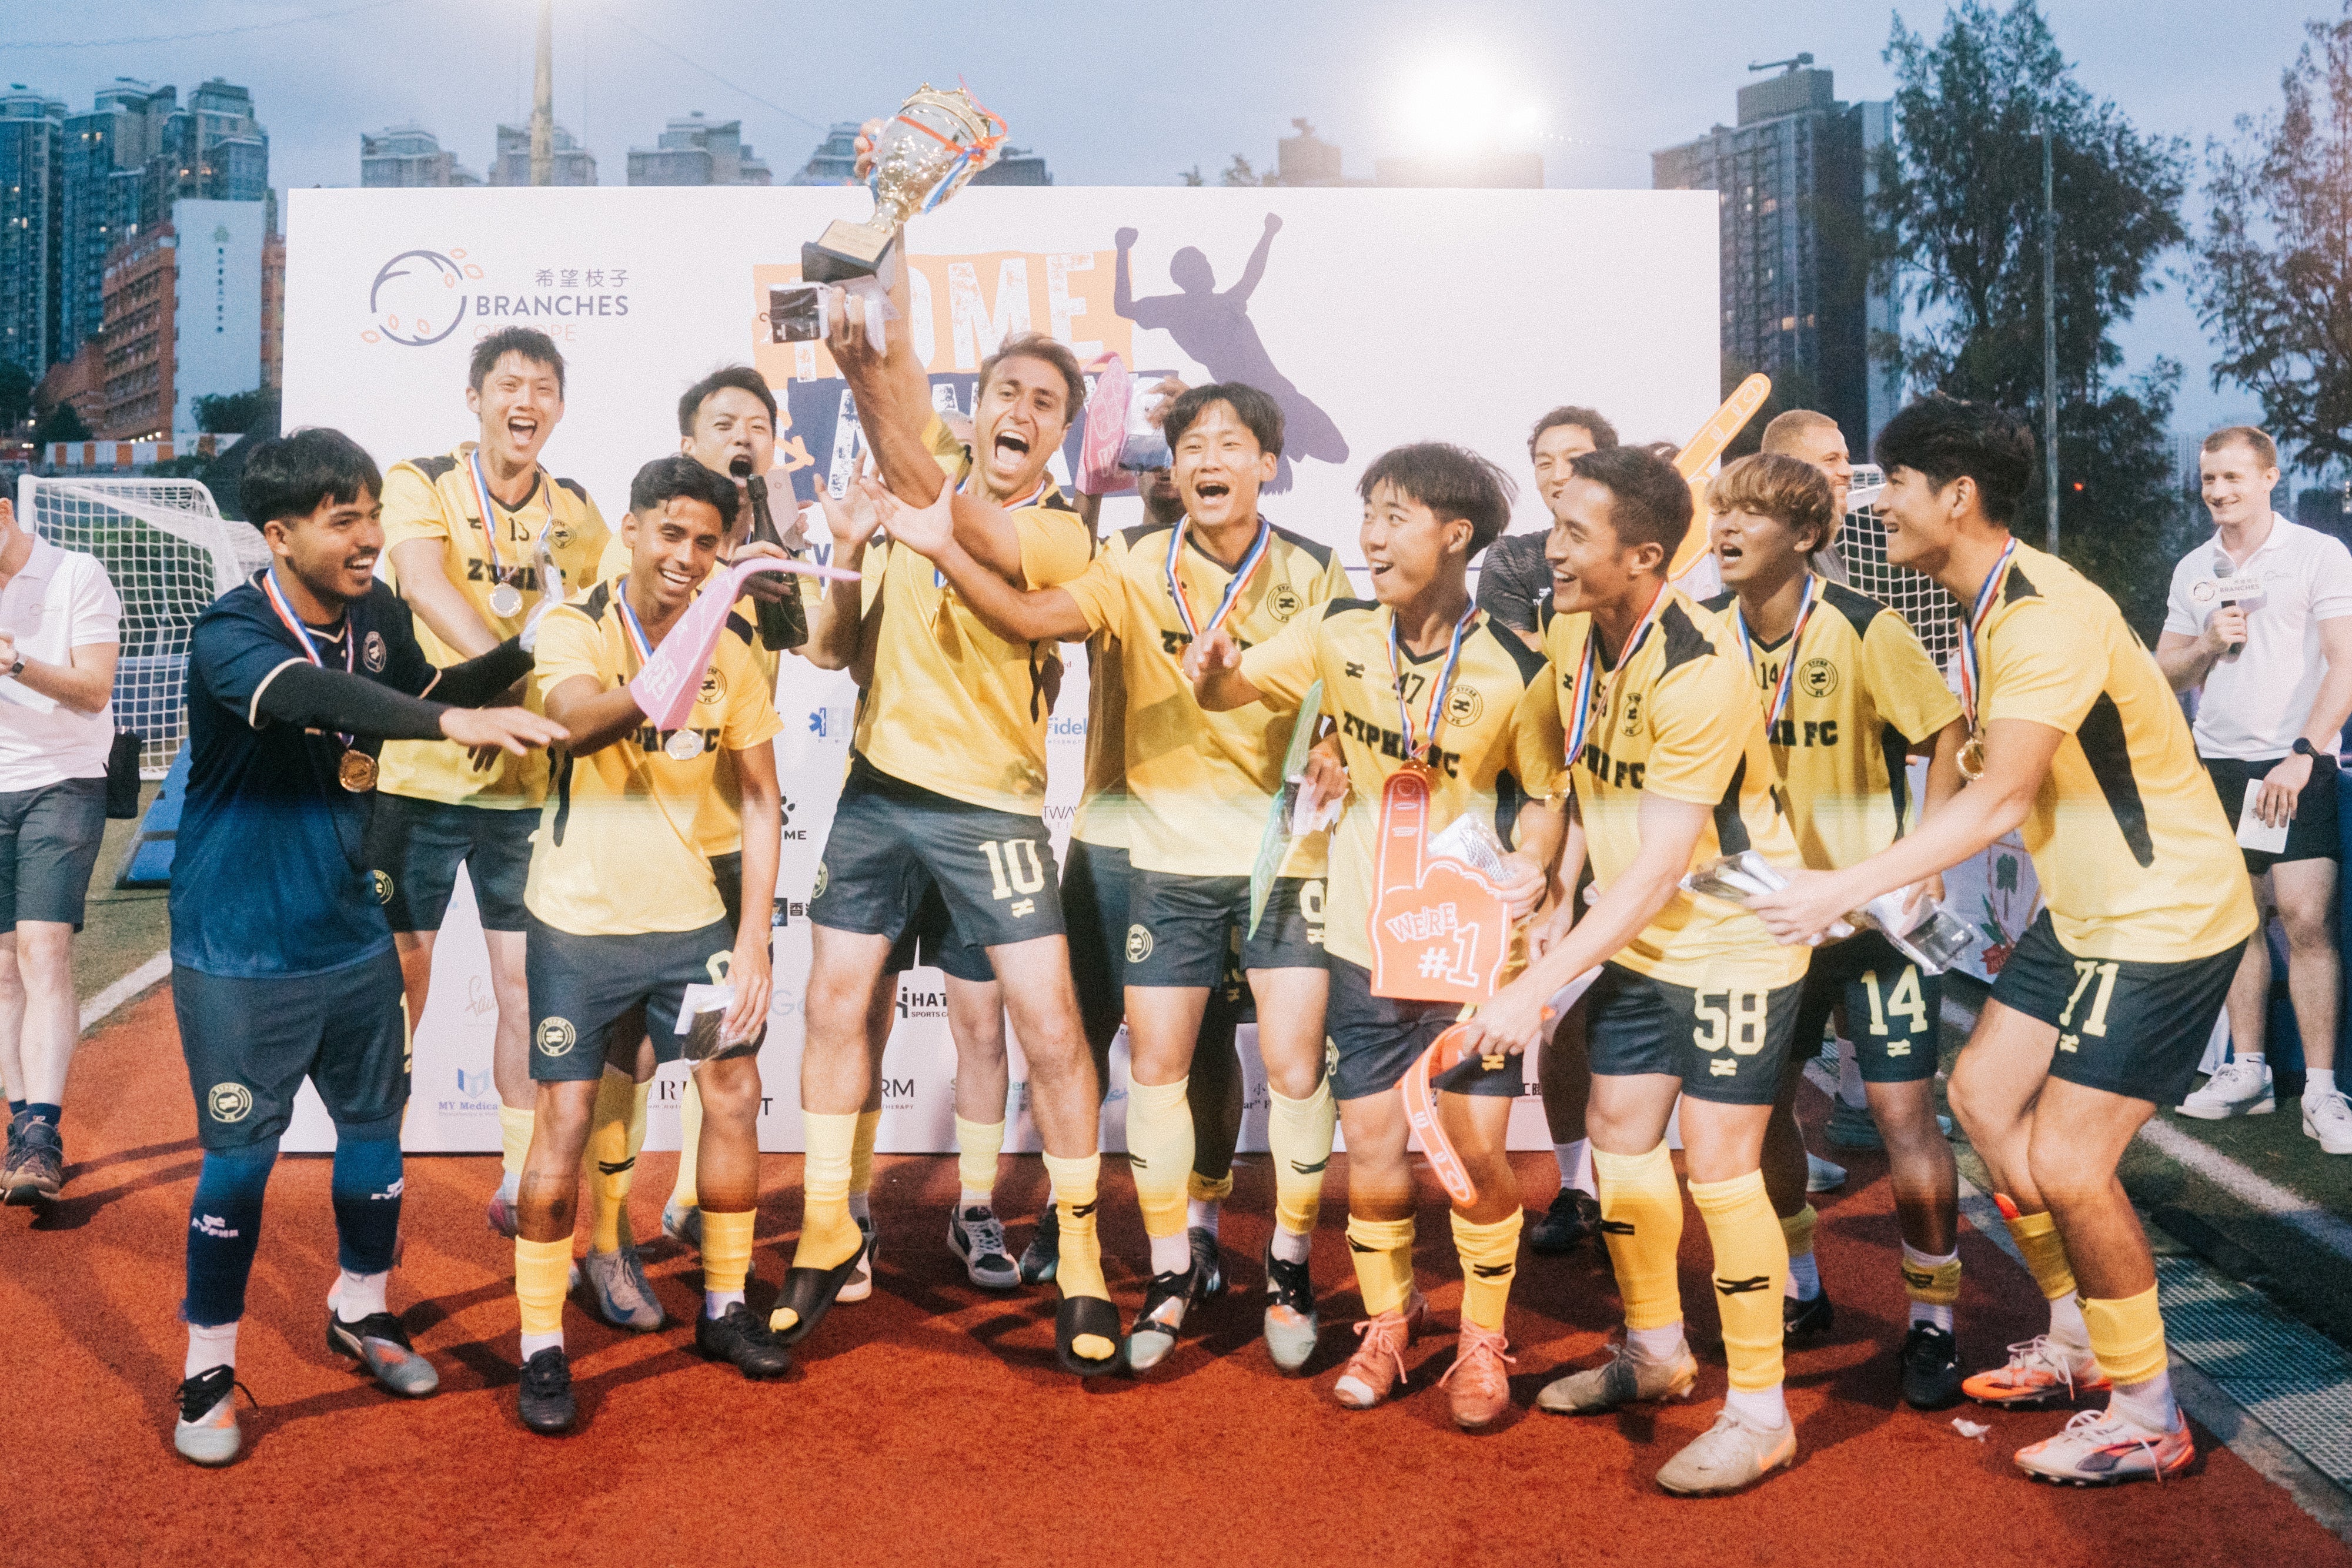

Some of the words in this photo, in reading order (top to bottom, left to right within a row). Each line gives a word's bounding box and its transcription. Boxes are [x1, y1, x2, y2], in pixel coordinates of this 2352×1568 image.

[536, 269, 629, 287] 希望枝子
[477, 295, 629, 316] BRANCHES
[1804, 720, 1839, 747] FC
[1614, 760, 1645, 789] FC
[978, 838, 1045, 901] 10
[1417, 921, 1479, 988] #1
[1693, 988, 1768, 1056] 58
[1860, 964, 1928, 1037] 14
[2059, 960, 2119, 1038] 71
[438, 1101, 455, 1110] MY
